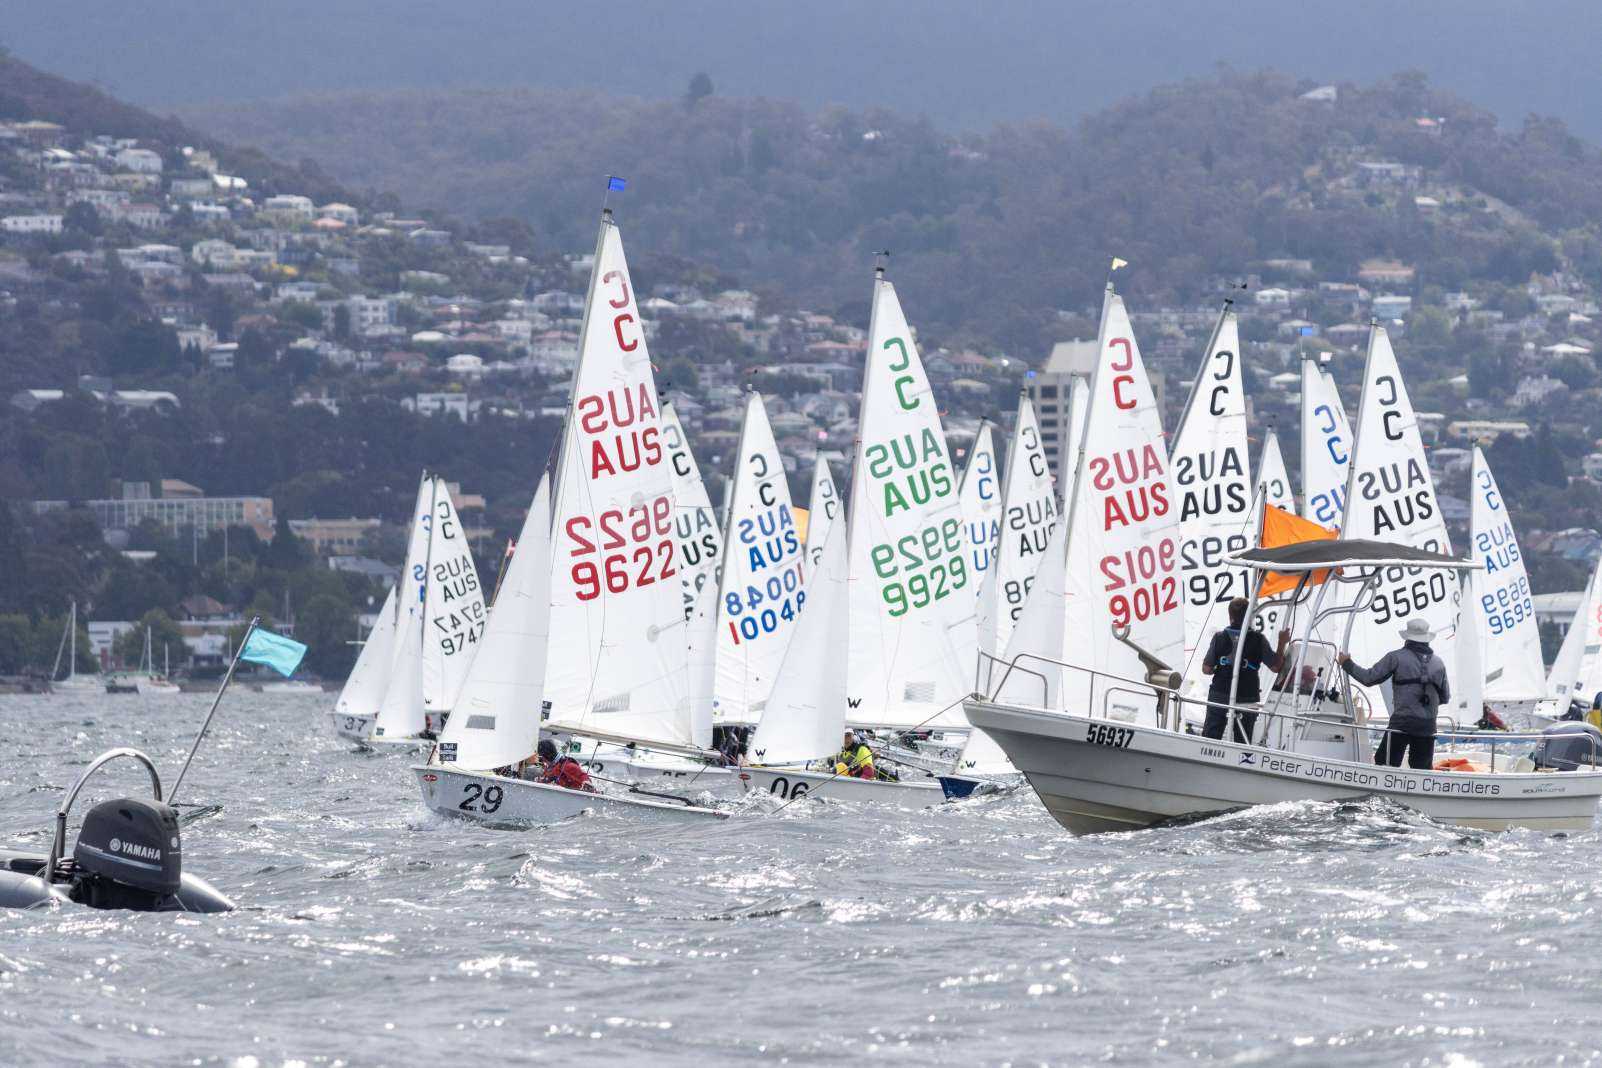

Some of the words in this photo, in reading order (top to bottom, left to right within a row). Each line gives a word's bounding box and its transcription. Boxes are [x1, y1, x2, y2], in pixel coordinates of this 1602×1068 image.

[614, 313, 638, 352] C
[894, 375, 920, 410] C
[1113, 375, 1137, 409] C
[1209, 385, 1229, 416] C
[1383, 410, 1404, 441] C
[592, 427, 661, 479] AUS
[672, 451, 691, 476] C
[1029, 453, 1044, 477] C
[1327, 436, 1348, 465] C
[759, 482, 776, 507] C
[883, 463, 951, 518] AUS
[978, 477, 993, 500] C
[1181, 482, 1246, 522] AUS
[1485, 490, 1499, 511] C
[1104, 482, 1169, 531] AUS
[1373, 490, 1433, 535] AUS
[443, 522, 454, 539] C
[681, 534, 717, 568] US
[749, 530, 798, 572] AUS
[1486, 543, 1519, 574] AUS
[571, 539, 676, 600] 9622
[882, 555, 967, 617] 9929
[443, 573, 477, 603] AUS
[1109, 576, 1178, 628] 9012
[1370, 572, 1445, 624] 9560
[1489, 598, 1532, 635] 9699
[441, 622, 485, 656] 9747
[344, 716, 367, 732] 37
[1086, 723, 1135, 749] 56937
[1261, 755, 1302, 775] Peter
[1305, 764, 1378, 786] Johnston
[1384, 774, 1416, 791] Ship
[1423, 778, 1500, 795] Chandlers
[458, 784, 503, 813] 29
[121, 841, 161, 861] YAMAHA
